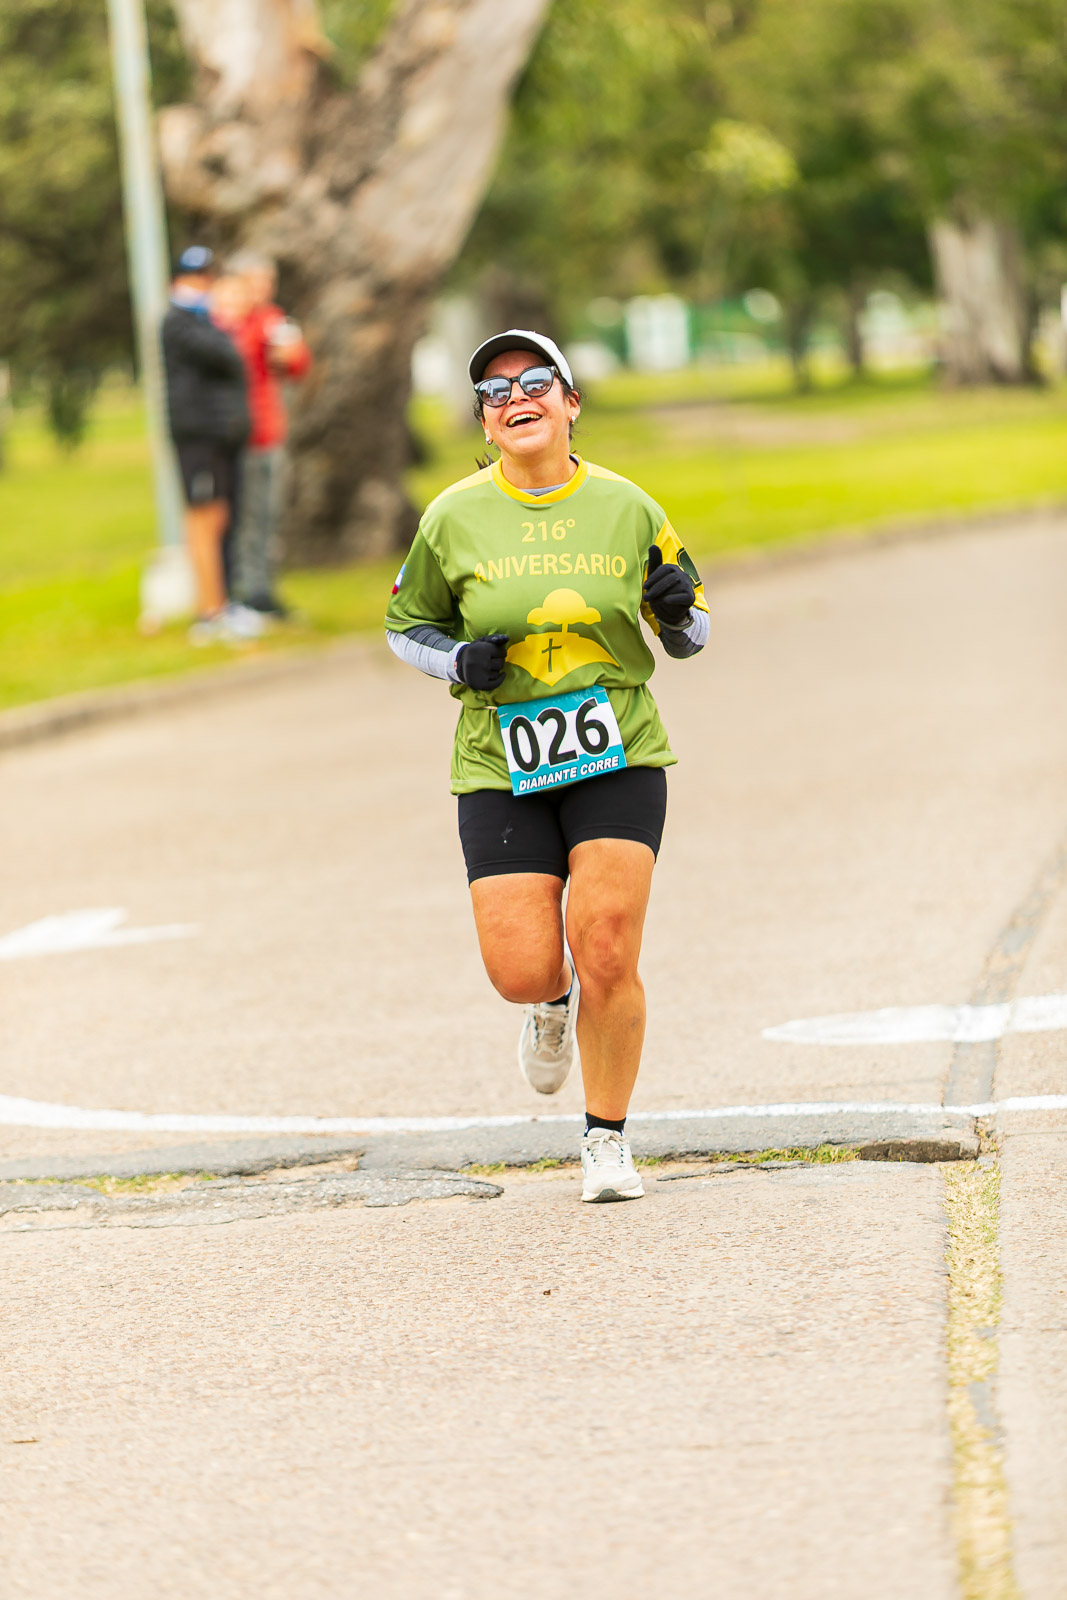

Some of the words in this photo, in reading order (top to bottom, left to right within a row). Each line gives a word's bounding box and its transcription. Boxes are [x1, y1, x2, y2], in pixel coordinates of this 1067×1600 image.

[521, 518, 576, 543] 216°
[474, 553, 627, 583] ANIVERSARIO
[509, 697, 610, 773] 026
[519, 767, 577, 792] DIAMANTE
[580, 756, 619, 776] CORRE
